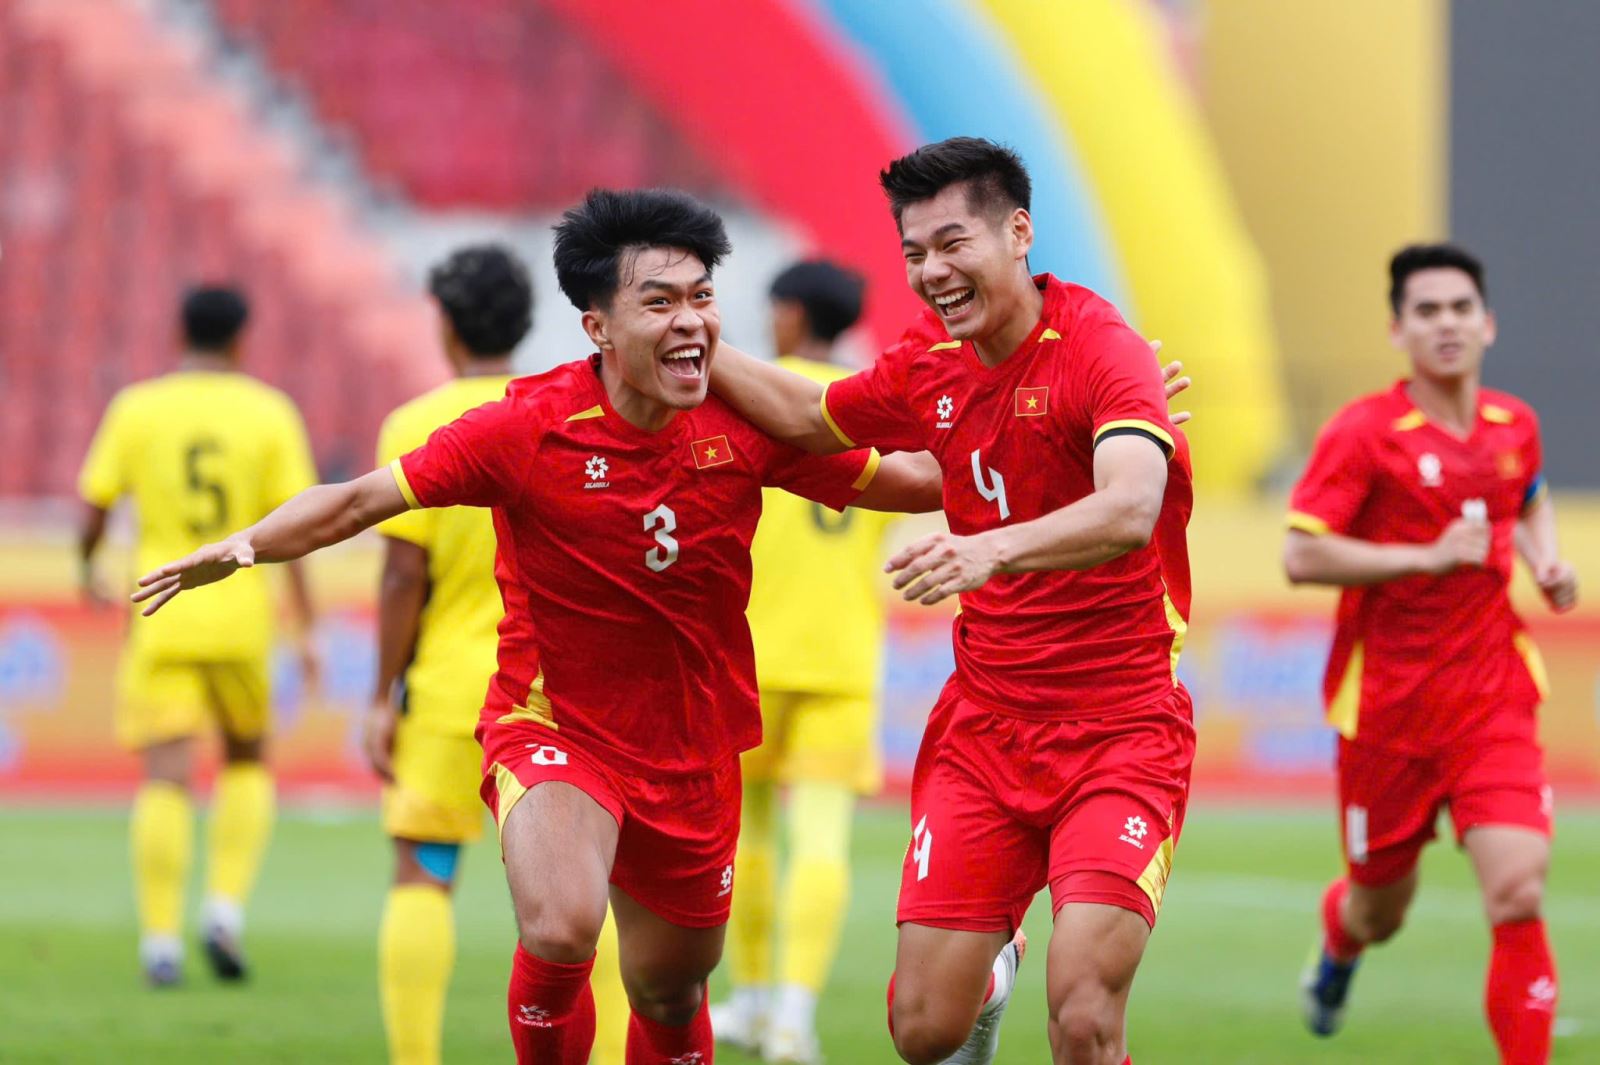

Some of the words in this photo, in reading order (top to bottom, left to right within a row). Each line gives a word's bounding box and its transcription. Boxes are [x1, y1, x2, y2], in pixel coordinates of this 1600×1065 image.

[184, 436, 229, 539] 5
[970, 448, 1011, 521] 4
[643, 503, 679, 573] 3
[913, 813, 932, 882] 4
